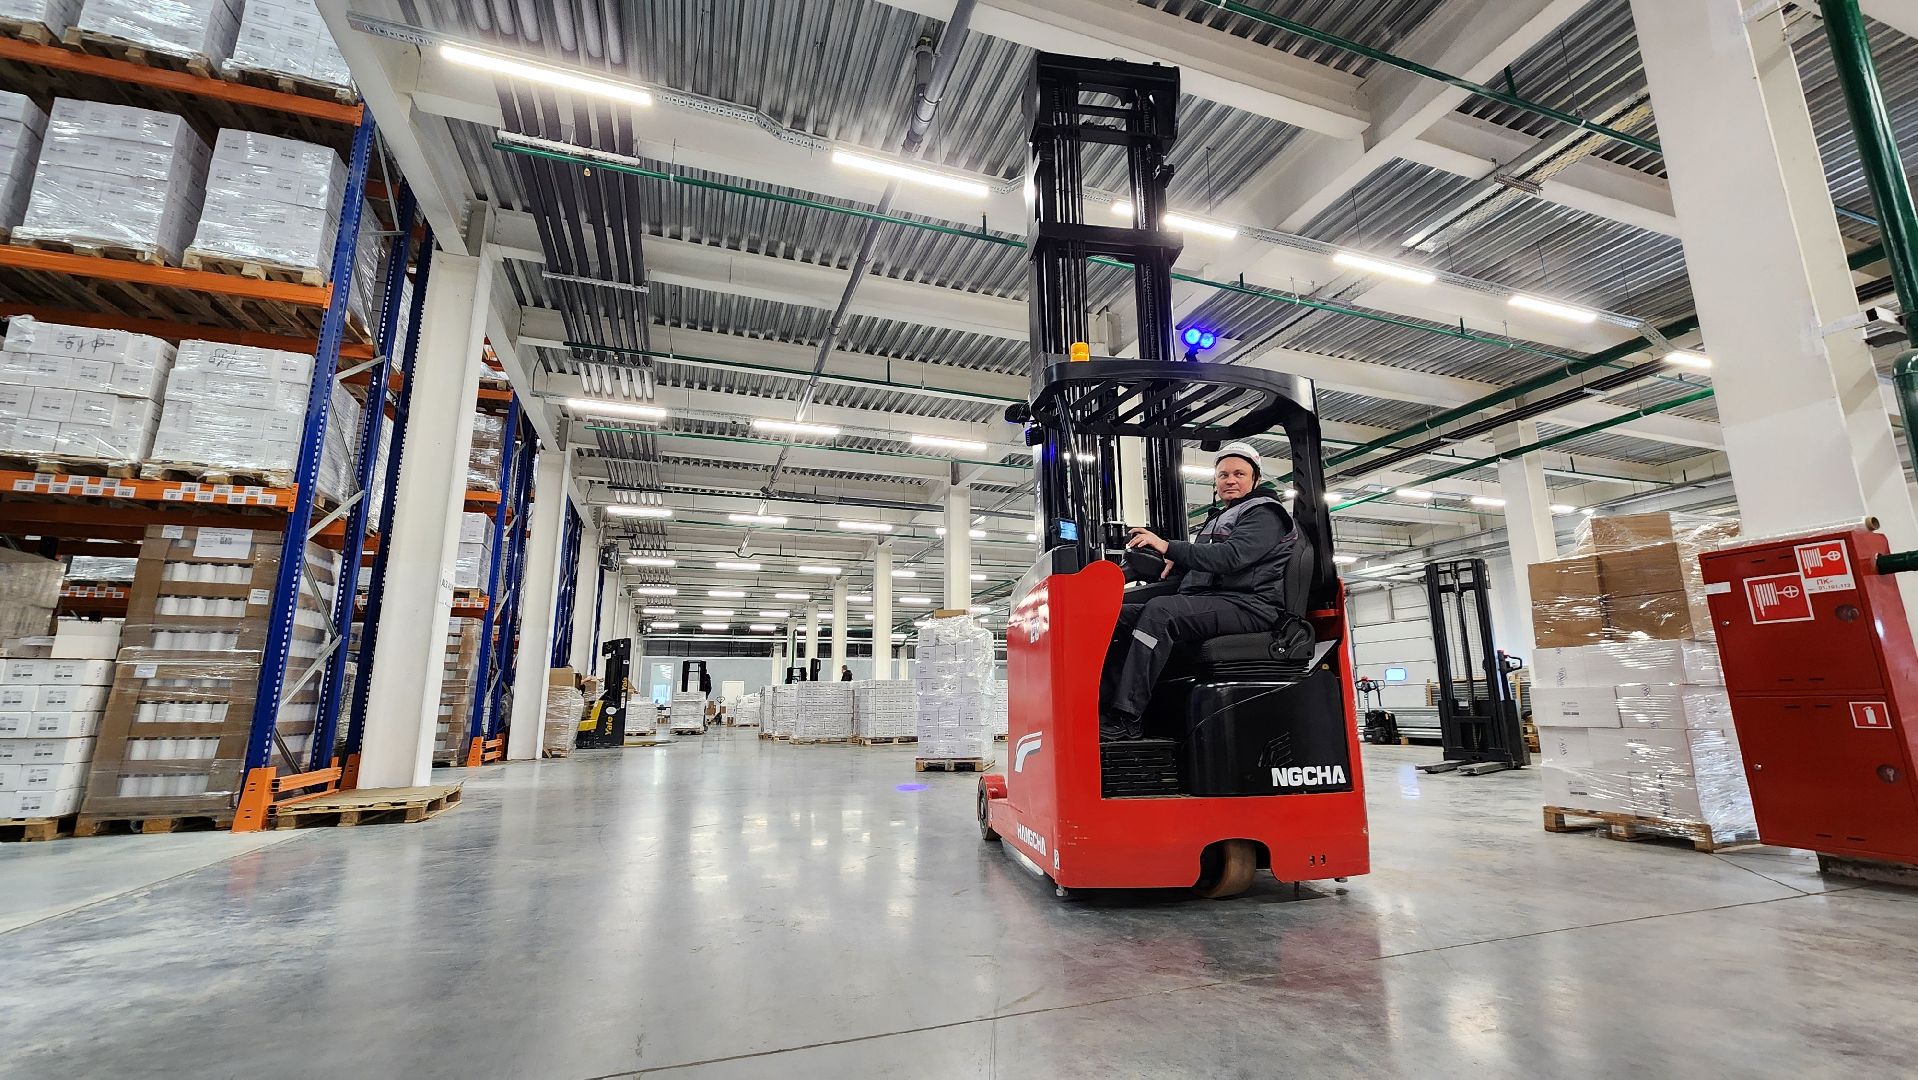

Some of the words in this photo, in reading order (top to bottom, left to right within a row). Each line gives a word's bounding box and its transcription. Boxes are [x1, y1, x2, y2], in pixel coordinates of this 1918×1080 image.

[605, 716, 613, 736] Yale
[1271, 765, 1347, 787] NGCHA
[1016, 822, 1046, 856] HANGCHA
